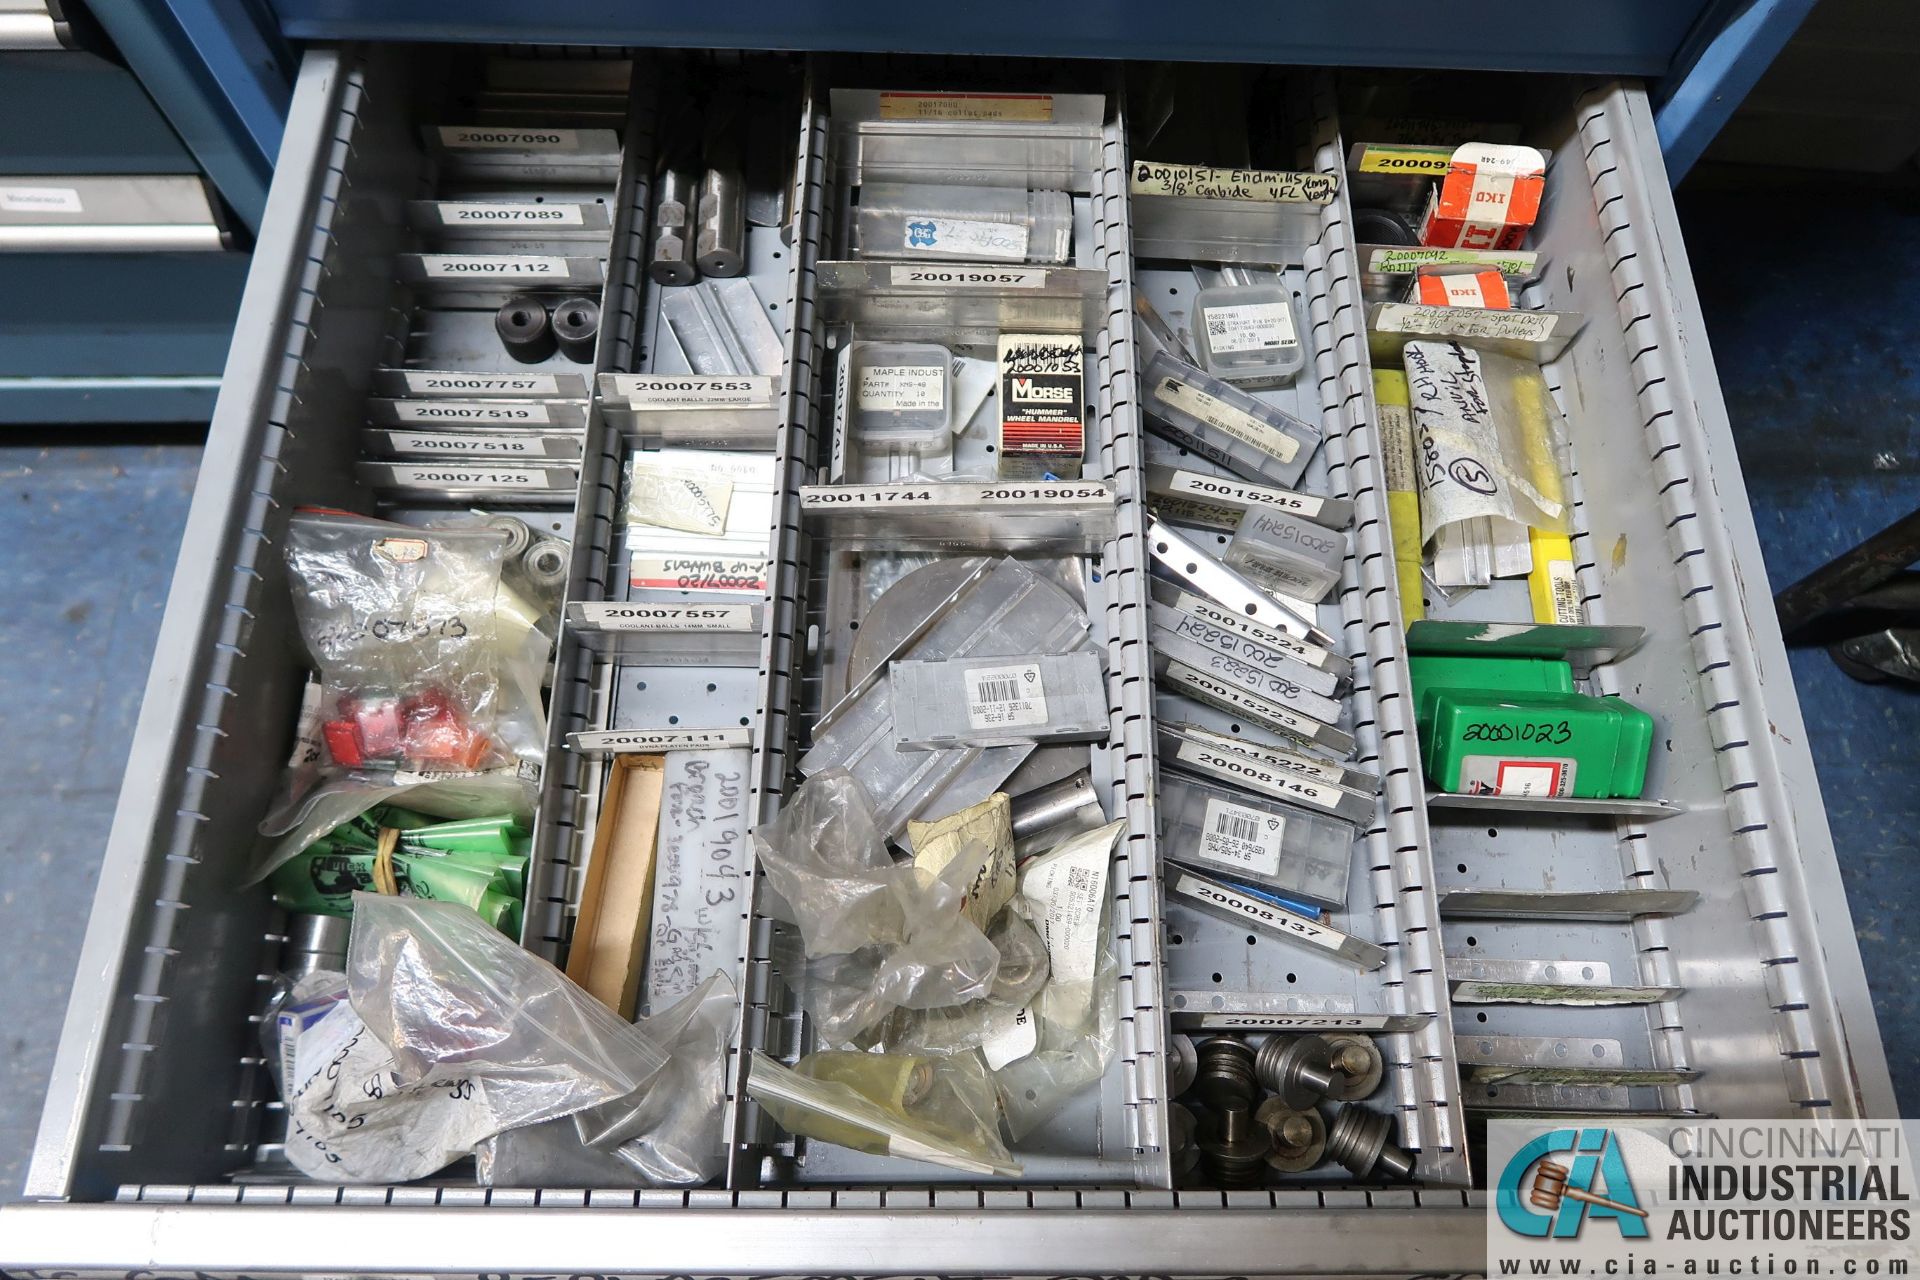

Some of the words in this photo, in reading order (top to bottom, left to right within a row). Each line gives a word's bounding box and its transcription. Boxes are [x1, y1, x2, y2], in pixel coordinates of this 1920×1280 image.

[458, 132, 561, 145] 20007090
[1377, 159, 1451, 169] 20009
[458, 209, 564, 220] 20007089
[442, 262, 550, 273] 20007112
[910, 272, 1026, 283] 20019057
[425, 378, 537, 390] 20007757
[635, 381, 752, 392] 20007553
[1012, 378, 1073, 402] MORSE
[415, 408, 529, 420] 20007519
[410, 438, 525, 451] 20007518
[413, 472, 529, 483] 20007125
[806, 491, 932, 503] 20011744
[981, 488, 1107, 500] 20019054
[1189, 480, 1303, 508] 20015245
[604, 608, 730, 618] 20007557
[1194, 605, 1307, 655] 20015224
[1185, 673, 1297, 726] 20015223
[1463, 721, 1572, 744] 20001023
[601, 734, 726, 744] 20007111
[1198, 753, 1318, 798] 20008146
[1197, 888, 1322, 936] 20008137
